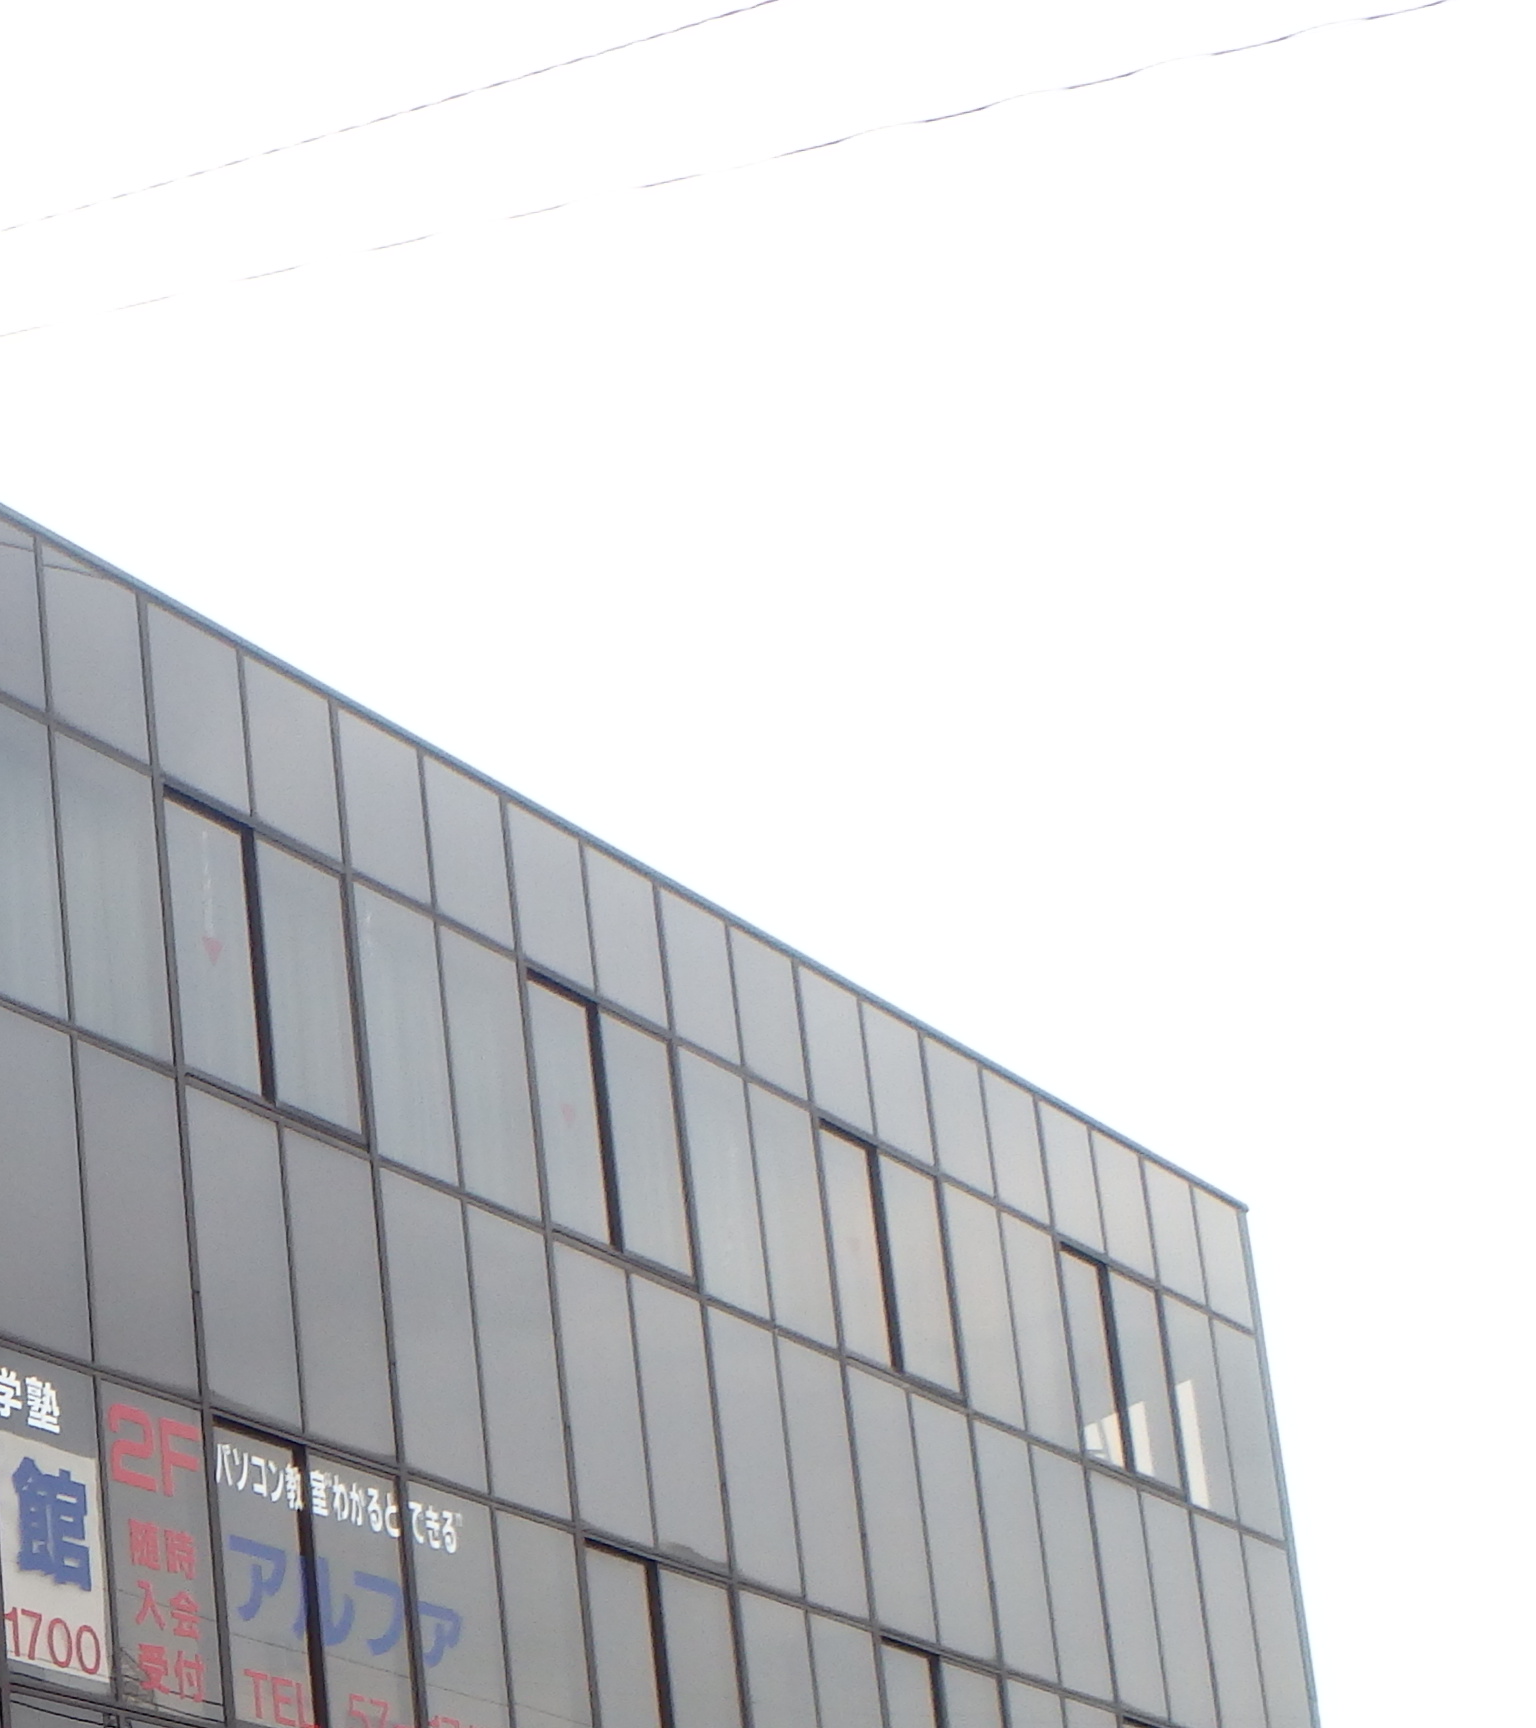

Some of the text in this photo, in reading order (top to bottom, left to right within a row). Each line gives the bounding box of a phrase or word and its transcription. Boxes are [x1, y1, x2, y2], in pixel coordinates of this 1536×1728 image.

[108, 1402, 201, 1497] 2F
[128, 1519, 197, 1581] 随時
[135, 1580, 203, 1642] 入会
[228, 1534, 464, 1668] アルファ
[138, 1642, 206, 1704] 受付
